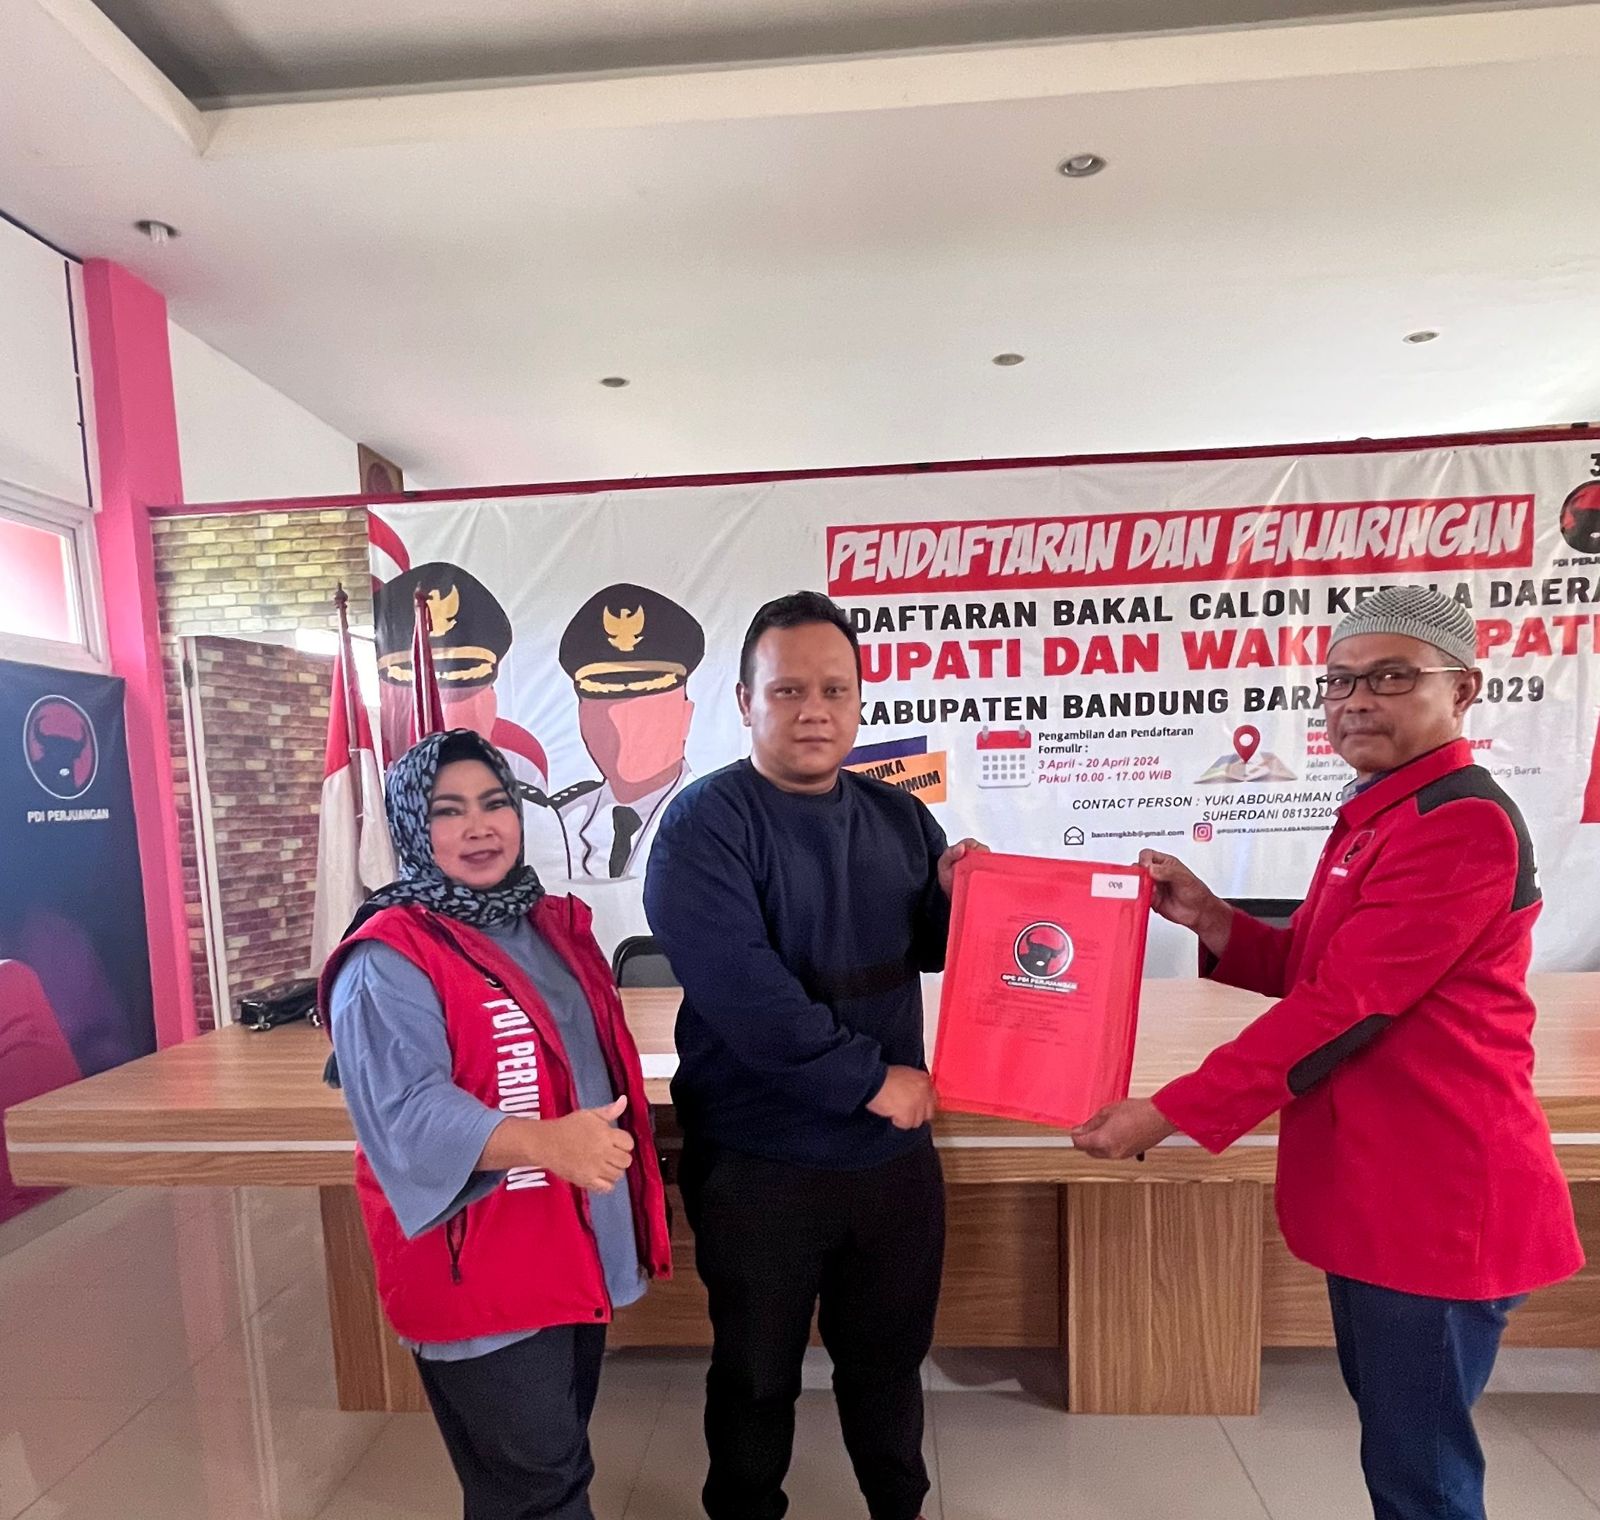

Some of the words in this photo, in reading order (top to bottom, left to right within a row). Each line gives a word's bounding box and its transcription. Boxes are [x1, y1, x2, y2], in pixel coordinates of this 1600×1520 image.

[828, 520, 1122, 583] PENDAFTARAN
[1127, 515, 1222, 571] DAN
[1226, 500, 1529, 566] PENJARINGAN
[841, 601, 1037, 633] DAFTARAN
[1053, 596, 1173, 626] BAKAL
[1190, 588, 1310, 620] CALON
[1327, 582, 1473, 614] KEA
[859, 637, 1021, 683] UPATI
[1043, 632, 1159, 677] DAN
[1181, 625, 1332, 671] WAKI
[1475, 614, 1600, 660] PAT
[1063, 688, 1229, 719] BANDUNG
[1244, 686, 1325, 712] BARA
[1474, 675, 1544, 703] 029
[1038, 730, 1105, 742] Pengambilan
[1107, 728, 1127, 739] dan
[1130, 727, 1194, 738] Pendaftaran
[1038, 744, 1083, 754] Formulir
[1038, 760, 1045, 769] 3
[1047, 758, 1075, 771] April
[1086, 758, 1099, 768] 20
[1102, 757, 1130, 769] April
[1133, 756, 1160, 767] 2024
[1514, 766, 1542, 776] Barat
[1038, 773, 1071, 784] Pukul
[1075, 772, 1105, 783] 10.00
[1116, 771, 1145, 782] 17.00
[1149, 770, 1172, 780] WIB
[1072, 798, 1135, 810] CONTACT
[1137, 796, 1193, 808] PERSON
[1204, 795, 1234, 806] YUKI
[1236, 792, 1332, 805] ABDURAHMAN
[27, 811, 45, 823] PDI
[47, 808, 110, 822] PERJUANGAN
[1203, 809, 1279, 821] SUHERDANI
[1282, 807, 1333, 819] 0813220
[497, 1041, 550, 1191] PERJUN
